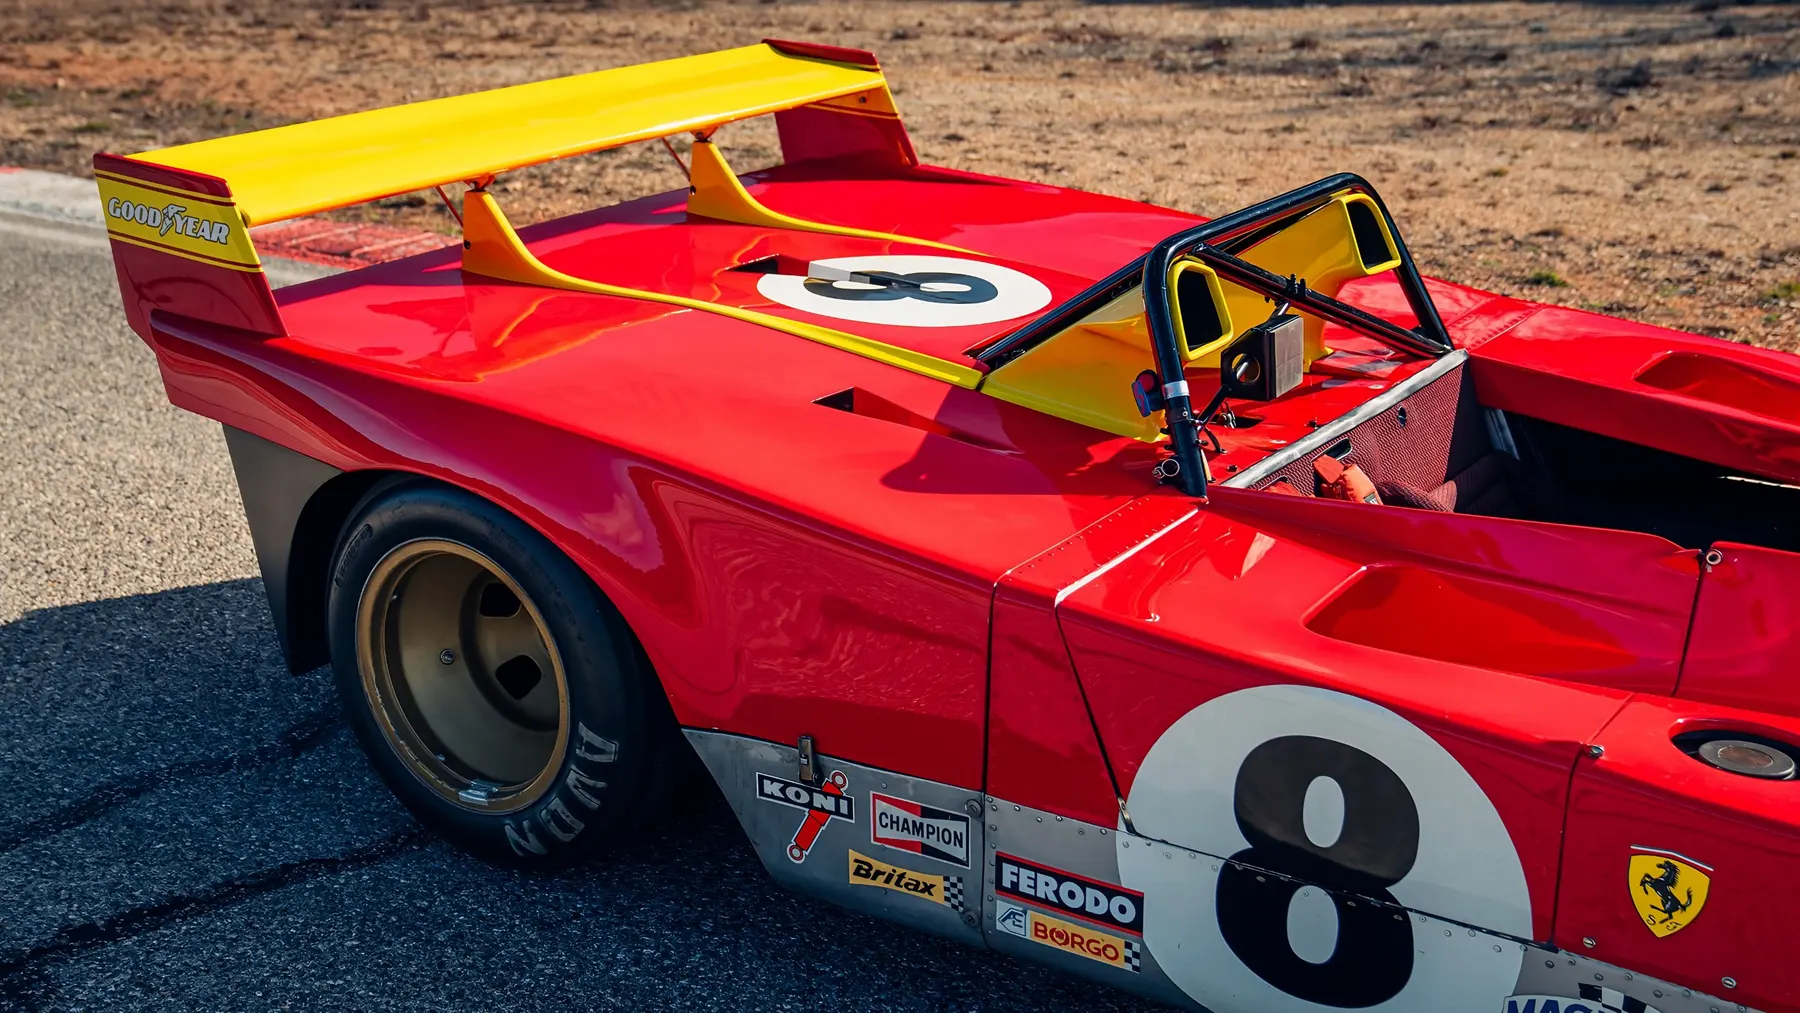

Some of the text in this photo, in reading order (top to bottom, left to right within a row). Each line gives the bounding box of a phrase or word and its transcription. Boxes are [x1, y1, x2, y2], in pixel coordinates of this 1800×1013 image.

[762, 778, 850, 816] KONI
[878, 811, 964, 849] CHAMPION
[852, 858, 937, 897] Britax
[1216, 735, 1420, 1009] 8
[1001, 862, 1137, 924] FERODO
[1033, 921, 1120, 961] BORGO
